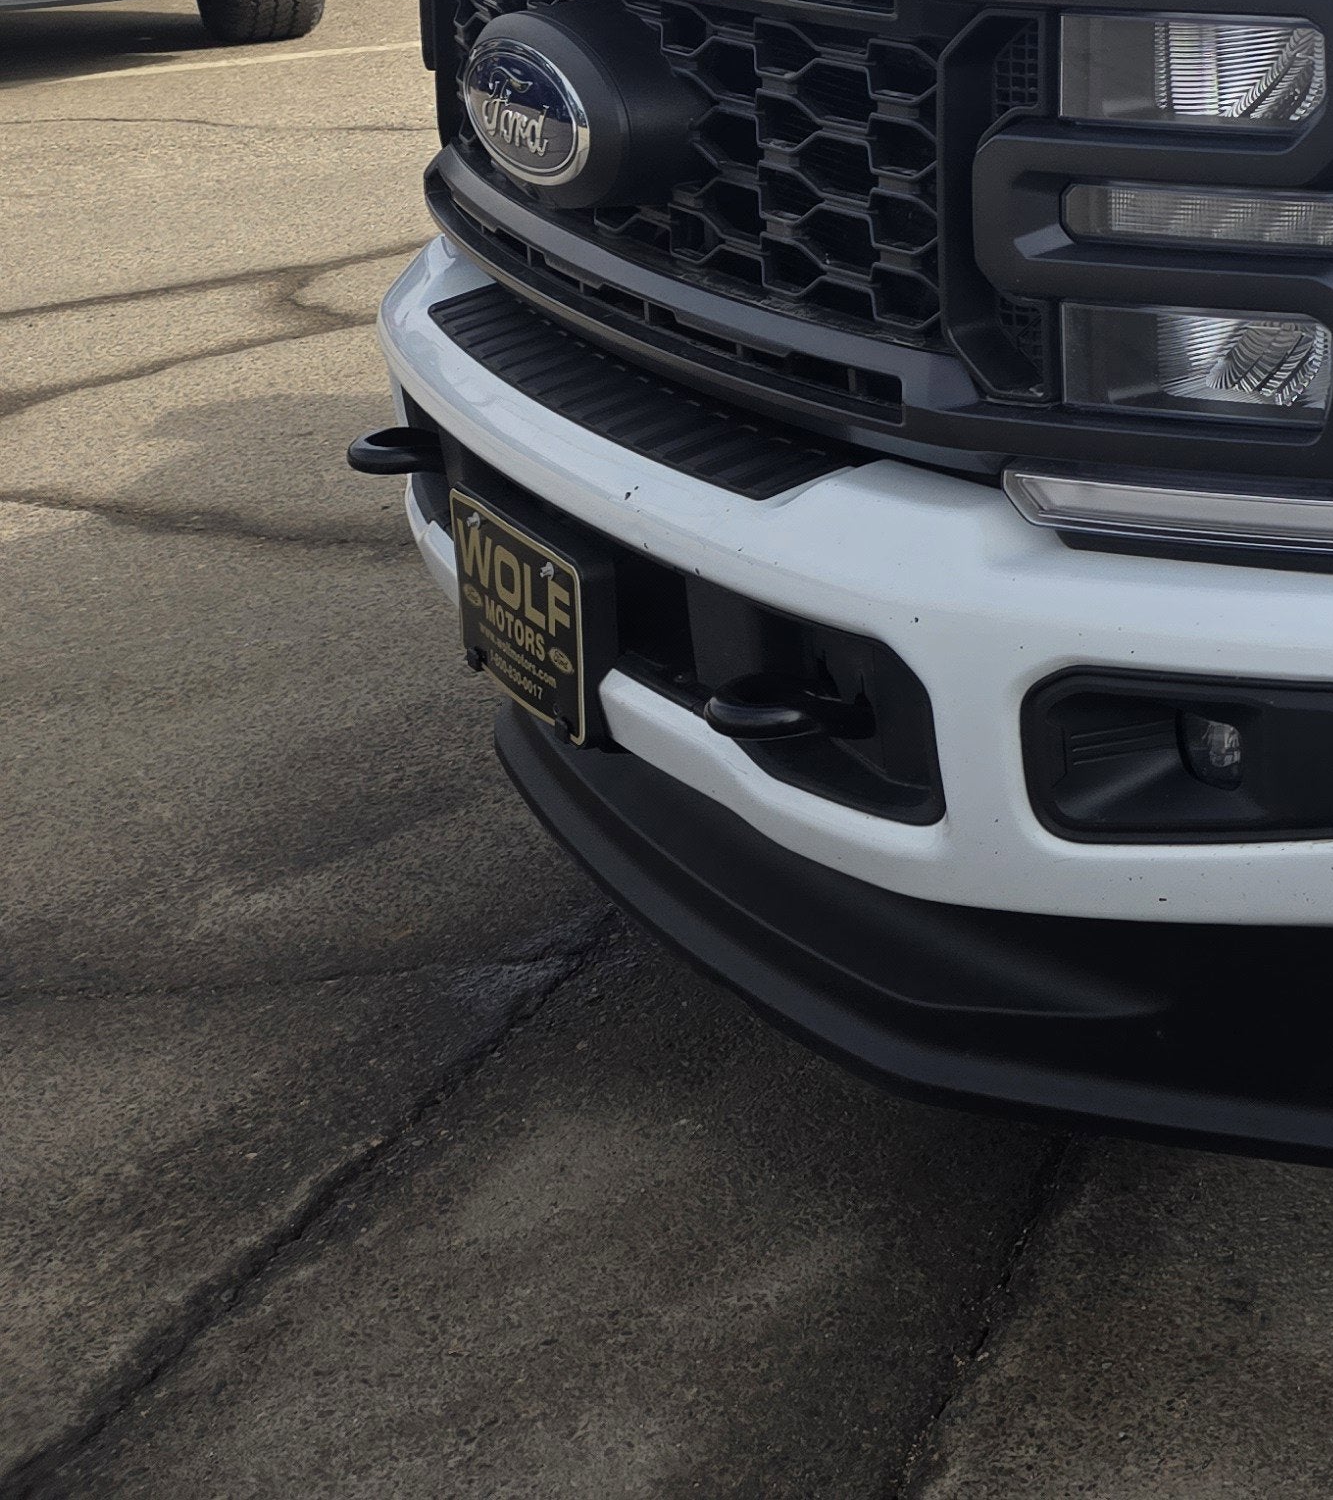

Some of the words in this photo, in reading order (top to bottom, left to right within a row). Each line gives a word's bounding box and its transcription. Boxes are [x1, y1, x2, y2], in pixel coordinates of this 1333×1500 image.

[482, 66, 549, 157] Ford
[457, 517, 571, 637] WOLF
[485, 593, 546, 662] MOTORS
